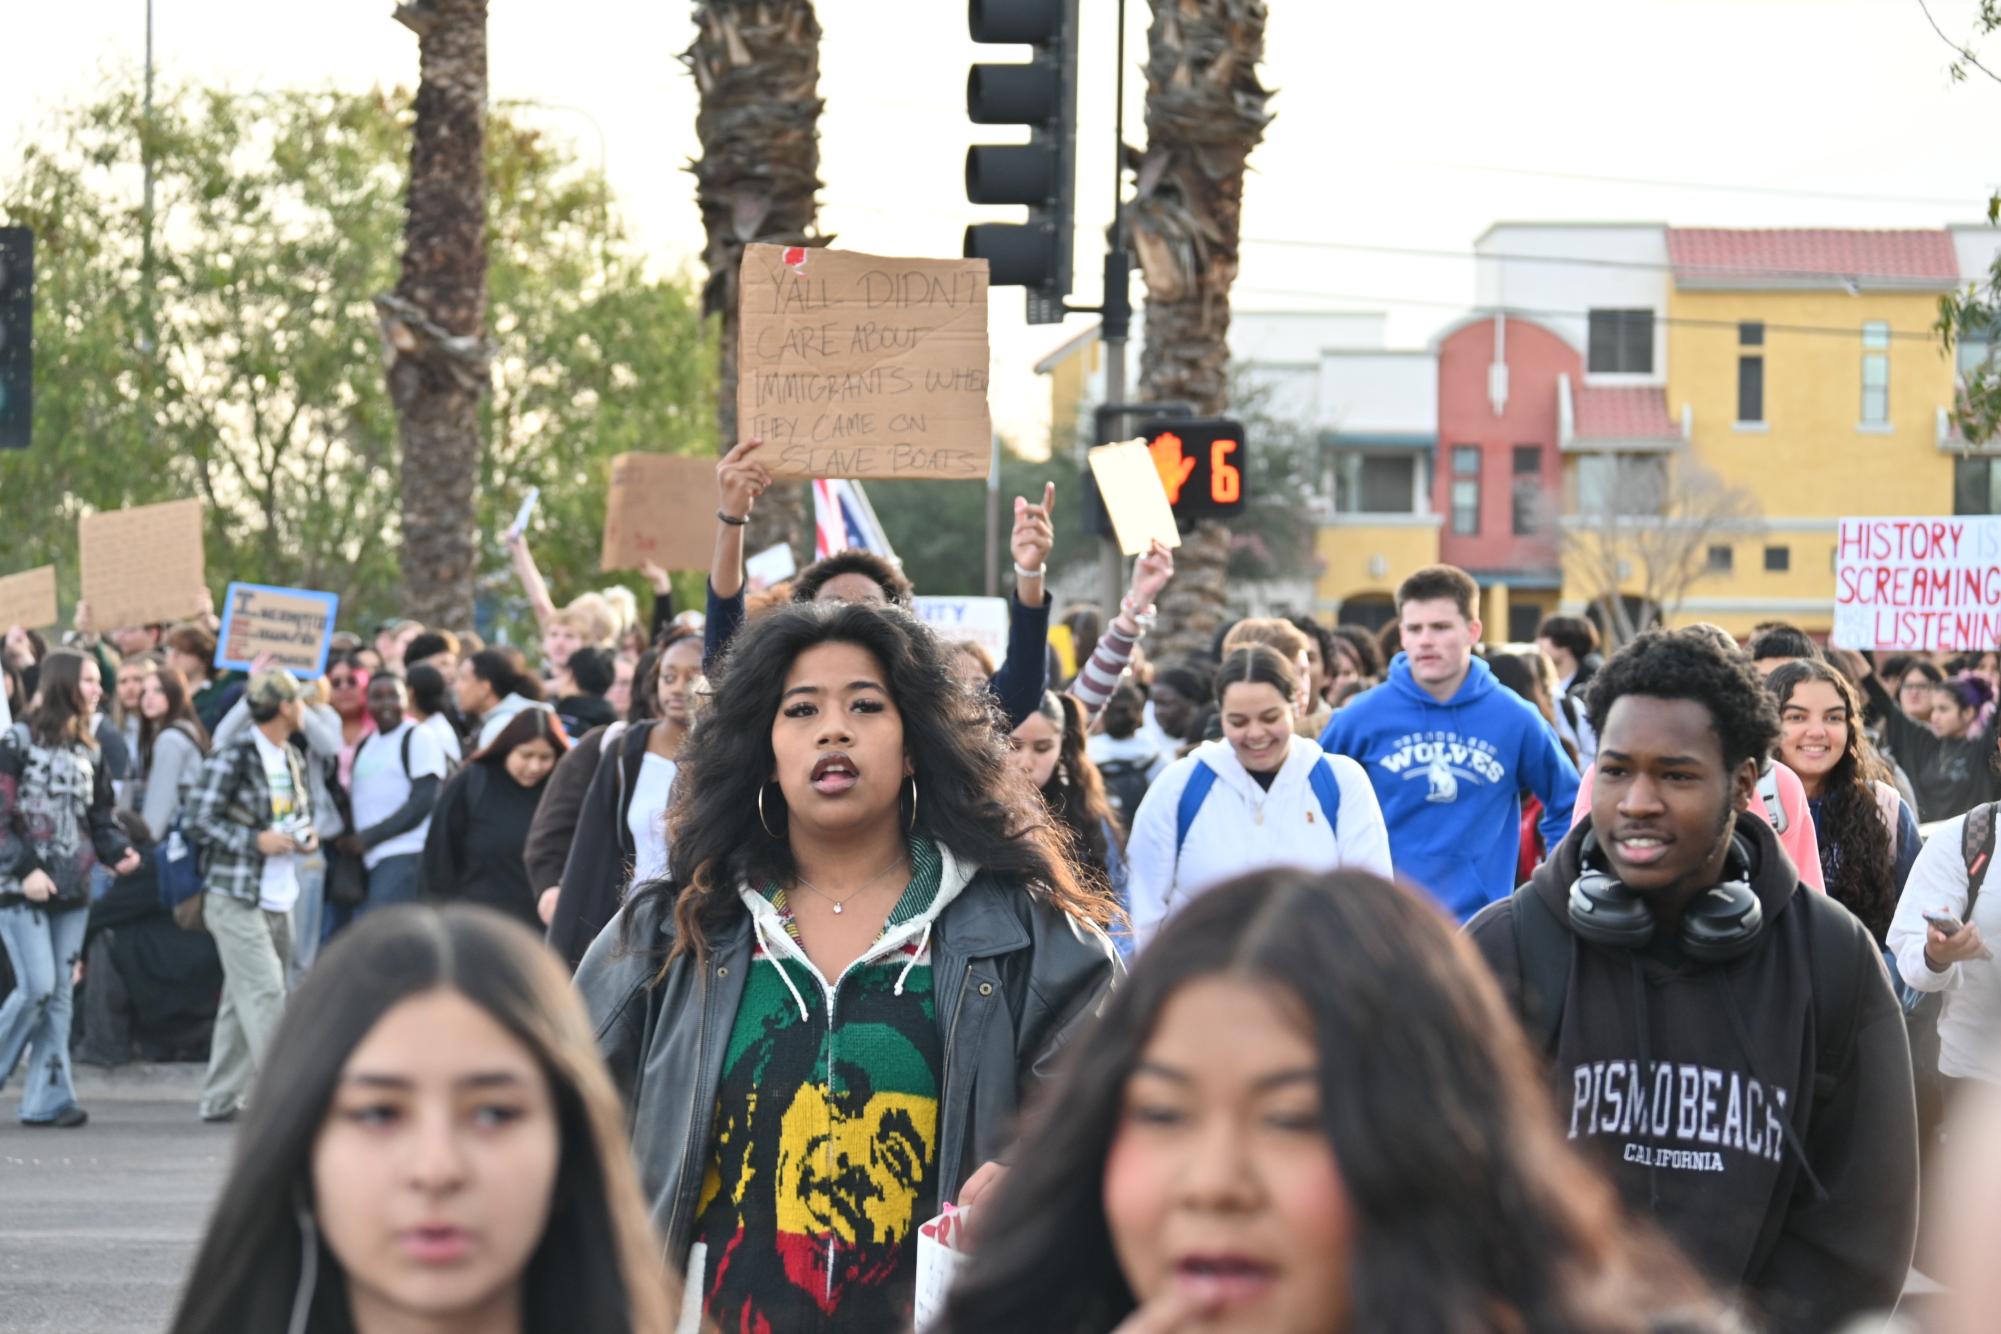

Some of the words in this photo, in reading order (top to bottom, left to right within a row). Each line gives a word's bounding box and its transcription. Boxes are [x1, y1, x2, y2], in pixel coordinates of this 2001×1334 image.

[856, 269, 989, 310] DIDN'T
[756, 321, 839, 361] CARE
[850, 320, 934, 354] ABOUT
[753, 365, 914, 409] IMMIGRANTS
[750, 413, 800, 445] THEY
[811, 412, 877, 443] CAME
[887, 413, 928, 433] ON
[774, 444, 877, 475] SLAVE
[888, 442, 978, 473] BOATS
[1210, 439, 1241, 504] 6
[1839, 521, 1964, 561] HISTORY
[1977, 521, 2000, 560] IS
[1836, 565, 2001, 607] SCREAMING
[1874, 610, 2001, 652] LISTENIN
[1378, 741, 1505, 784] WOLVES
[1567, 1059, 1673, 1140] PISMO
[1623, 1142, 1725, 1172] CALIFORNIA
